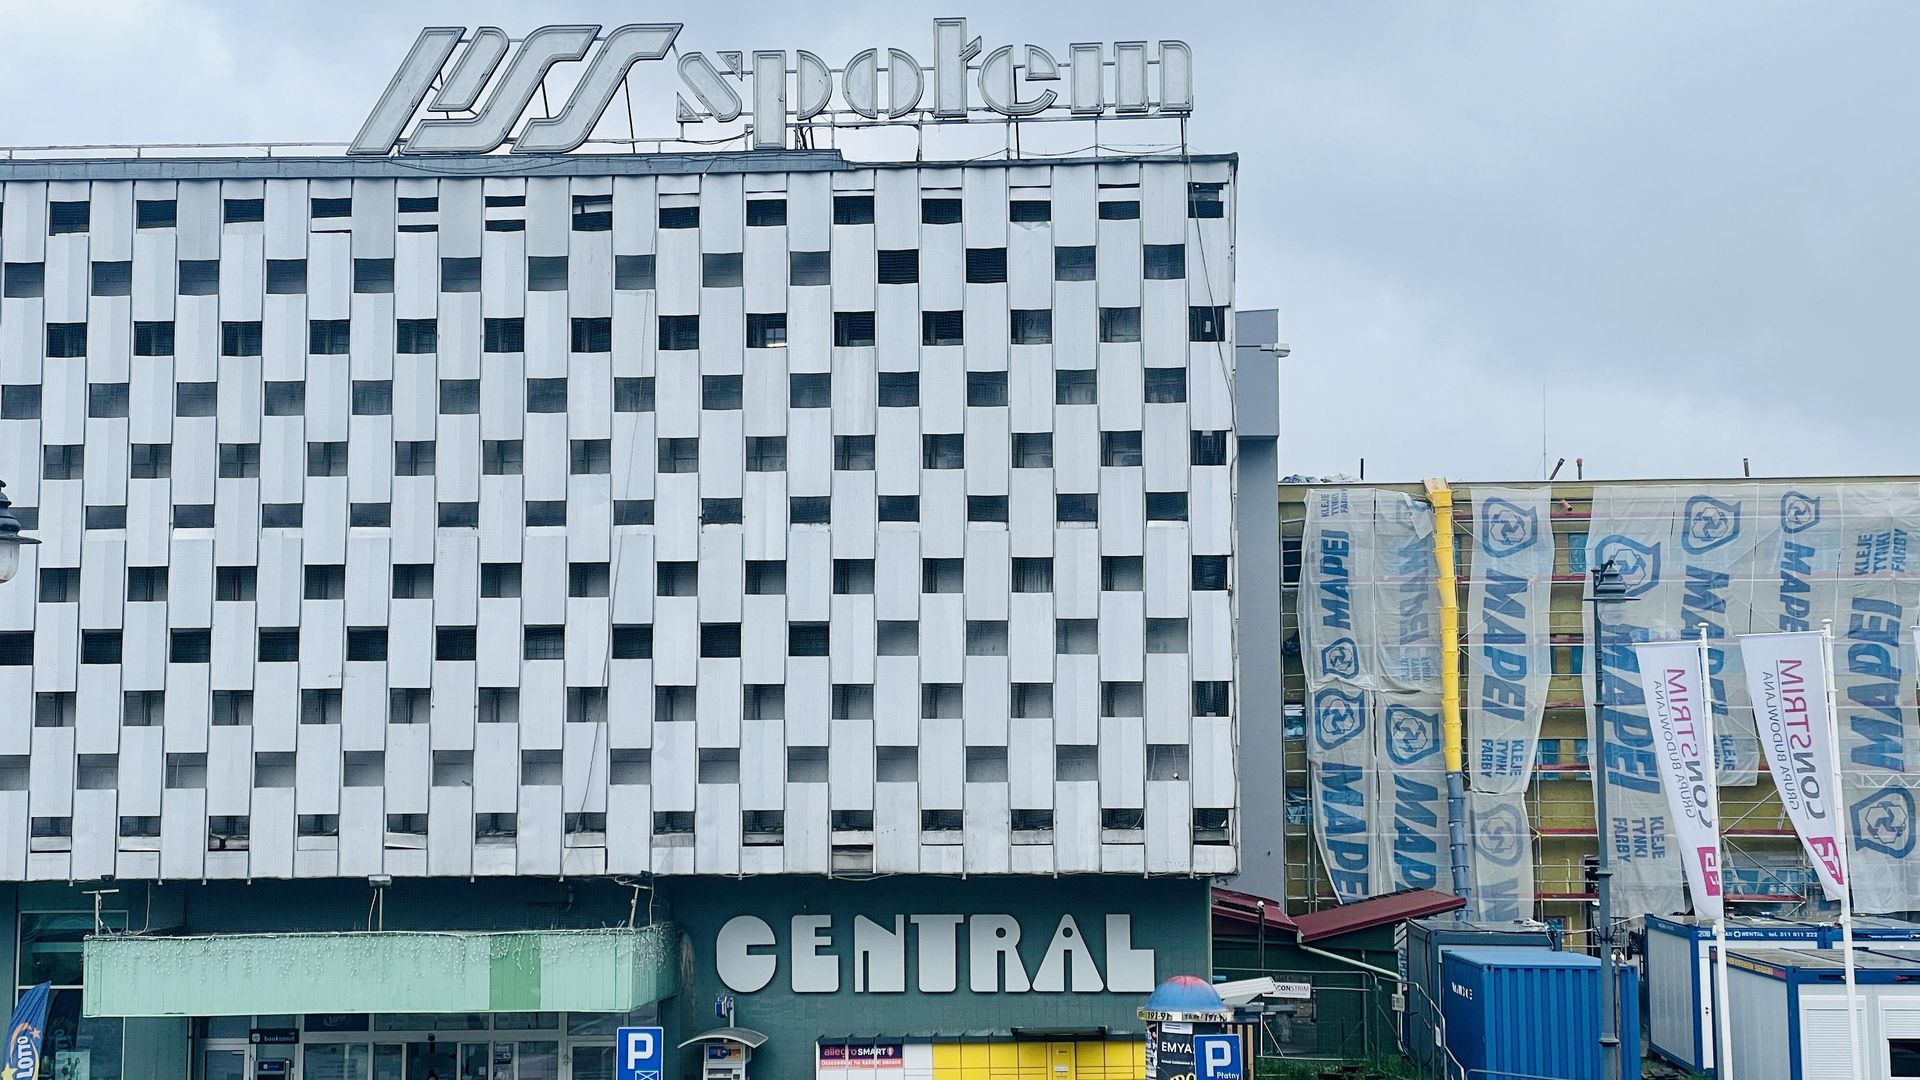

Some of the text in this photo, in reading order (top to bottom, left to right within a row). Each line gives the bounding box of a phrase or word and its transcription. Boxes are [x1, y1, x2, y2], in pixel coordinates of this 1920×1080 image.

[676, 17, 1194, 150] społem
[1854, 533, 1874, 576] KLEJE
[1872, 532, 1891, 574] TYNKI
[1891, 528, 1909, 573] FARBY
[1319, 529, 1351, 631] MAPEI
[1779, 540, 1816, 632] MAPE
[1482, 567, 1529, 722] MAPEI
[1848, 597, 1905, 773] MAPEI
[1480, 738, 1494, 779] FARBY
[1495, 739, 1510, 776] TYNKI
[1511, 739, 1525, 777] KLEJE
[1393, 772, 1439, 893] MAP
[1612, 817, 1632, 863] FARBY
[1631, 817, 1648, 859] TYNKI
[1648, 815, 1666, 860] KLEJE
[716, 913, 1155, 993] CENTRAL
[627, 1032, 654, 1070] P
[857, 1047, 887, 1056] SMART
[1161, 1041, 1194, 1054] EMYA
[1205, 1040, 1232, 1078] P
[1216, 1071, 1240, 1080] Płatny
